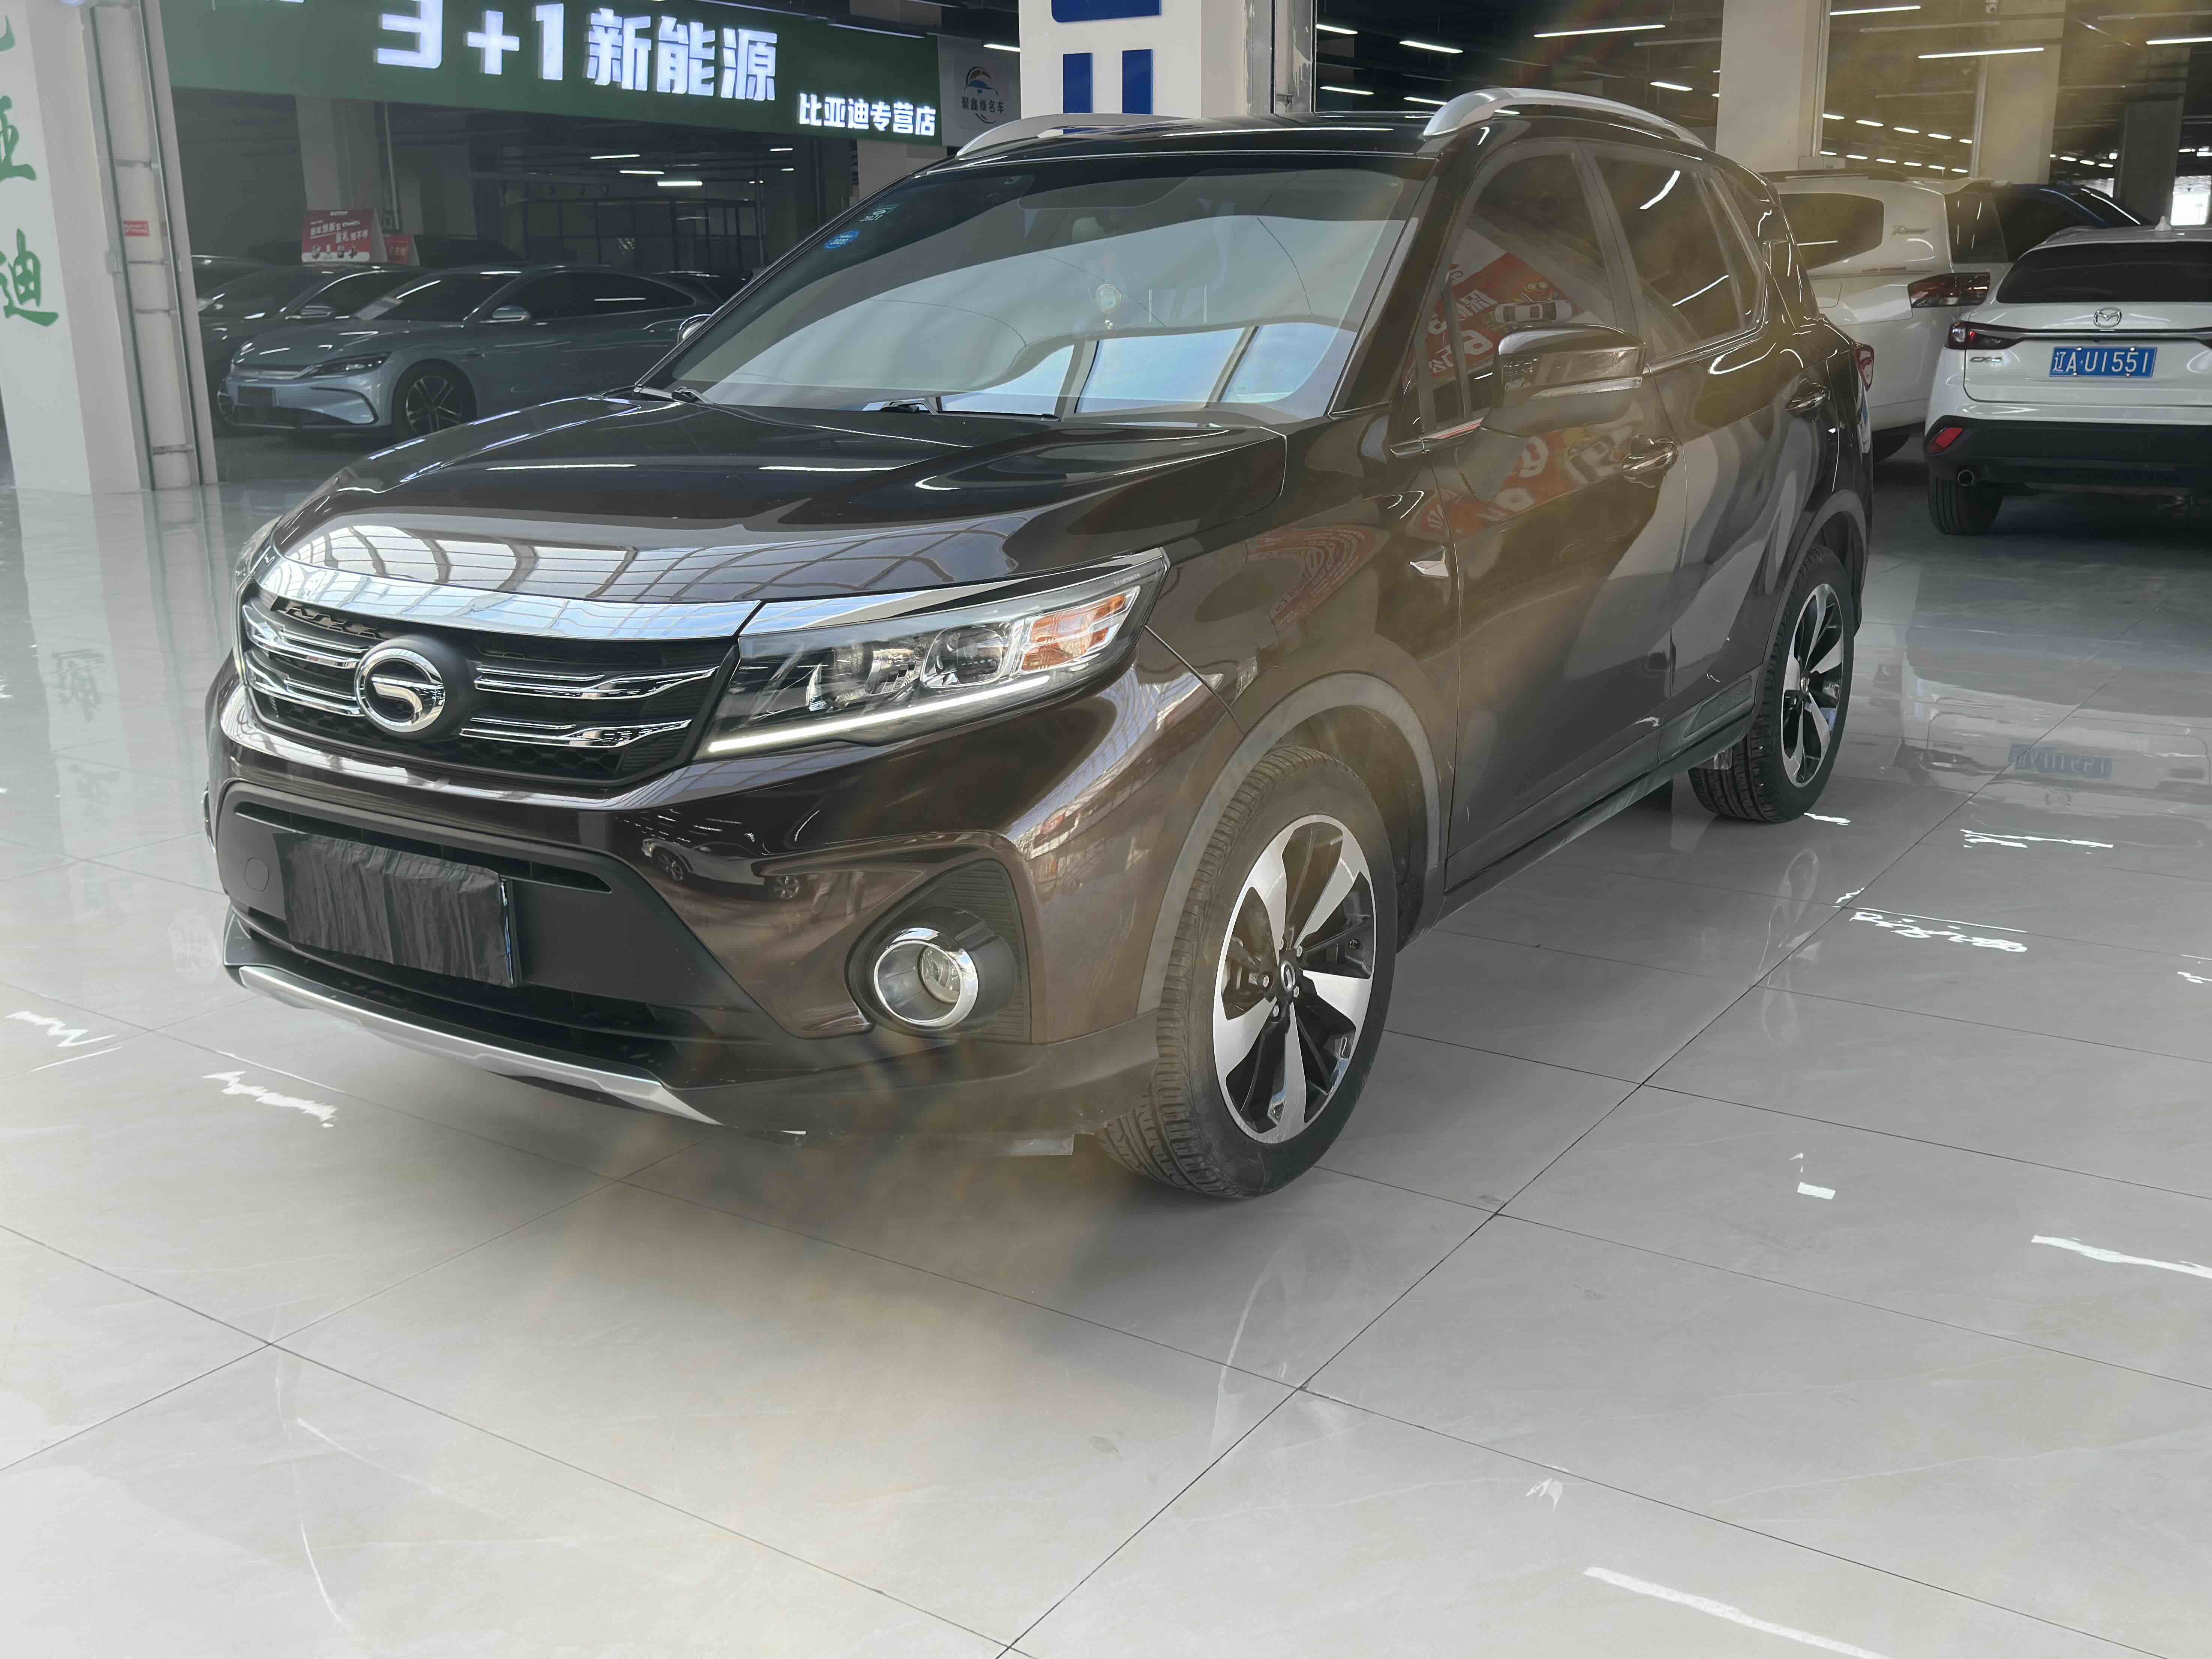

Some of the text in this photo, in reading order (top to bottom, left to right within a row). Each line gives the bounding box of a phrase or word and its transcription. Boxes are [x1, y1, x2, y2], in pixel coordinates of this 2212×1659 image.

[799, 93, 936, 136] 比亚迪专营店
